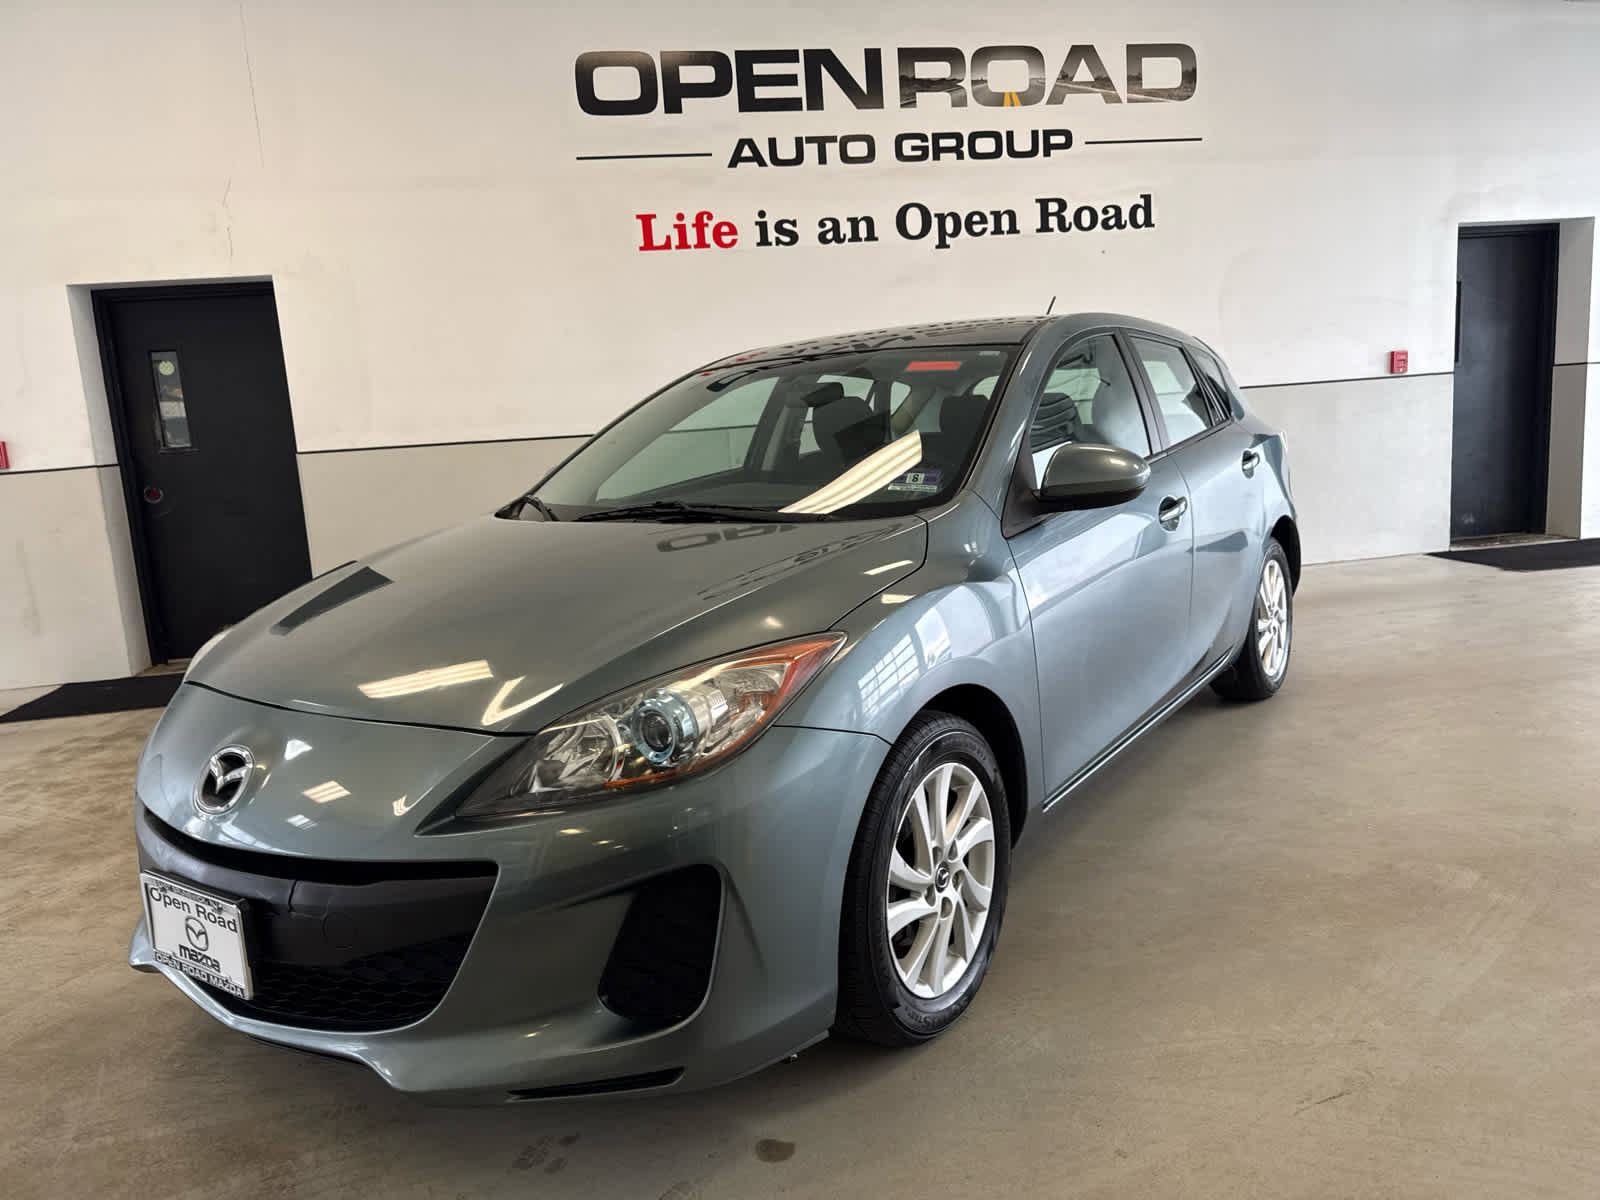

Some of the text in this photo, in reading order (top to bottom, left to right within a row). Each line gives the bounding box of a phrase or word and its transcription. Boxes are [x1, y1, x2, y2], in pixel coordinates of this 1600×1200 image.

[575, 43, 1198, 117] OPEN ROAD
[727, 128, 1074, 169] AUTO GROUP
[635, 193, 1156, 252] Life is an Open Road
[150, 887, 191, 914] Open
[195, 903, 239, 934] Road
